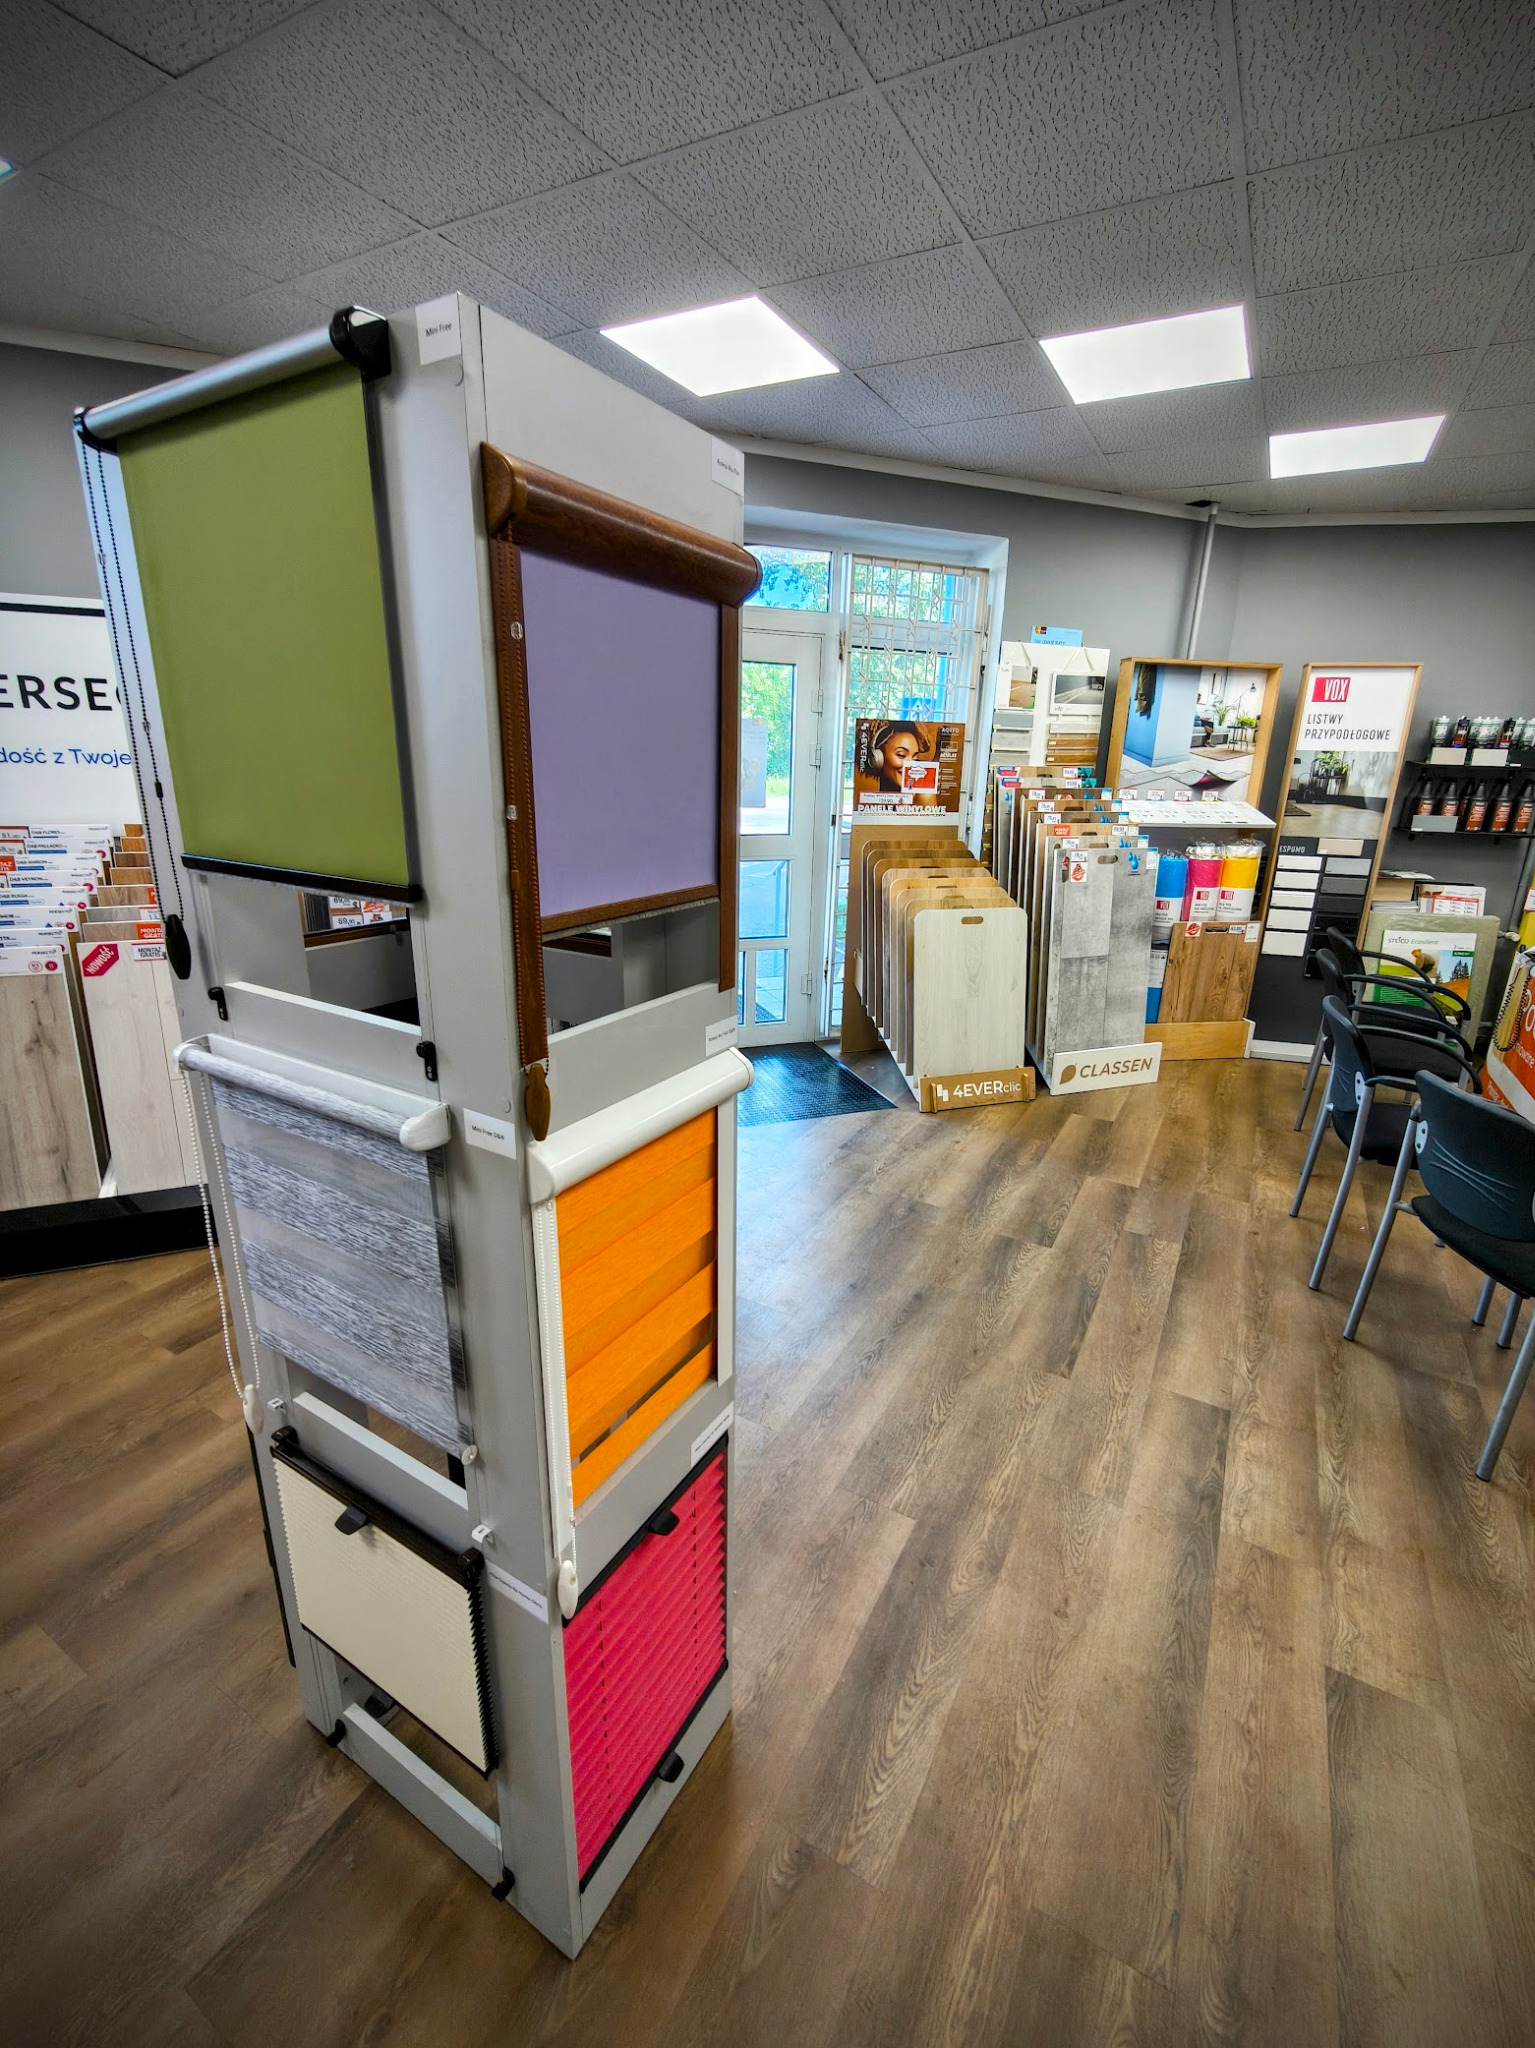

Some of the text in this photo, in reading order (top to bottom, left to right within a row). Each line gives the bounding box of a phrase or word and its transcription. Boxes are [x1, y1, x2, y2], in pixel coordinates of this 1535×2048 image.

[439, 323, 452, 332] Free
[0, 674, 120, 711] ERSE
[1323, 678, 1349, 701] VOX
[1307, 713, 1344, 725] LISTWY
[1304, 728, 1392, 741] PRZYPODŁOGOWE
[52, 752, 66, 765] z
[857, 804, 947, 813] PANELE WINYLOWE
[1279, 845, 1306, 854] ESPUMO
[1079, 1057, 1153, 1079] CLASSEN
[952, 1080, 1022, 1098] 4EVERclic
